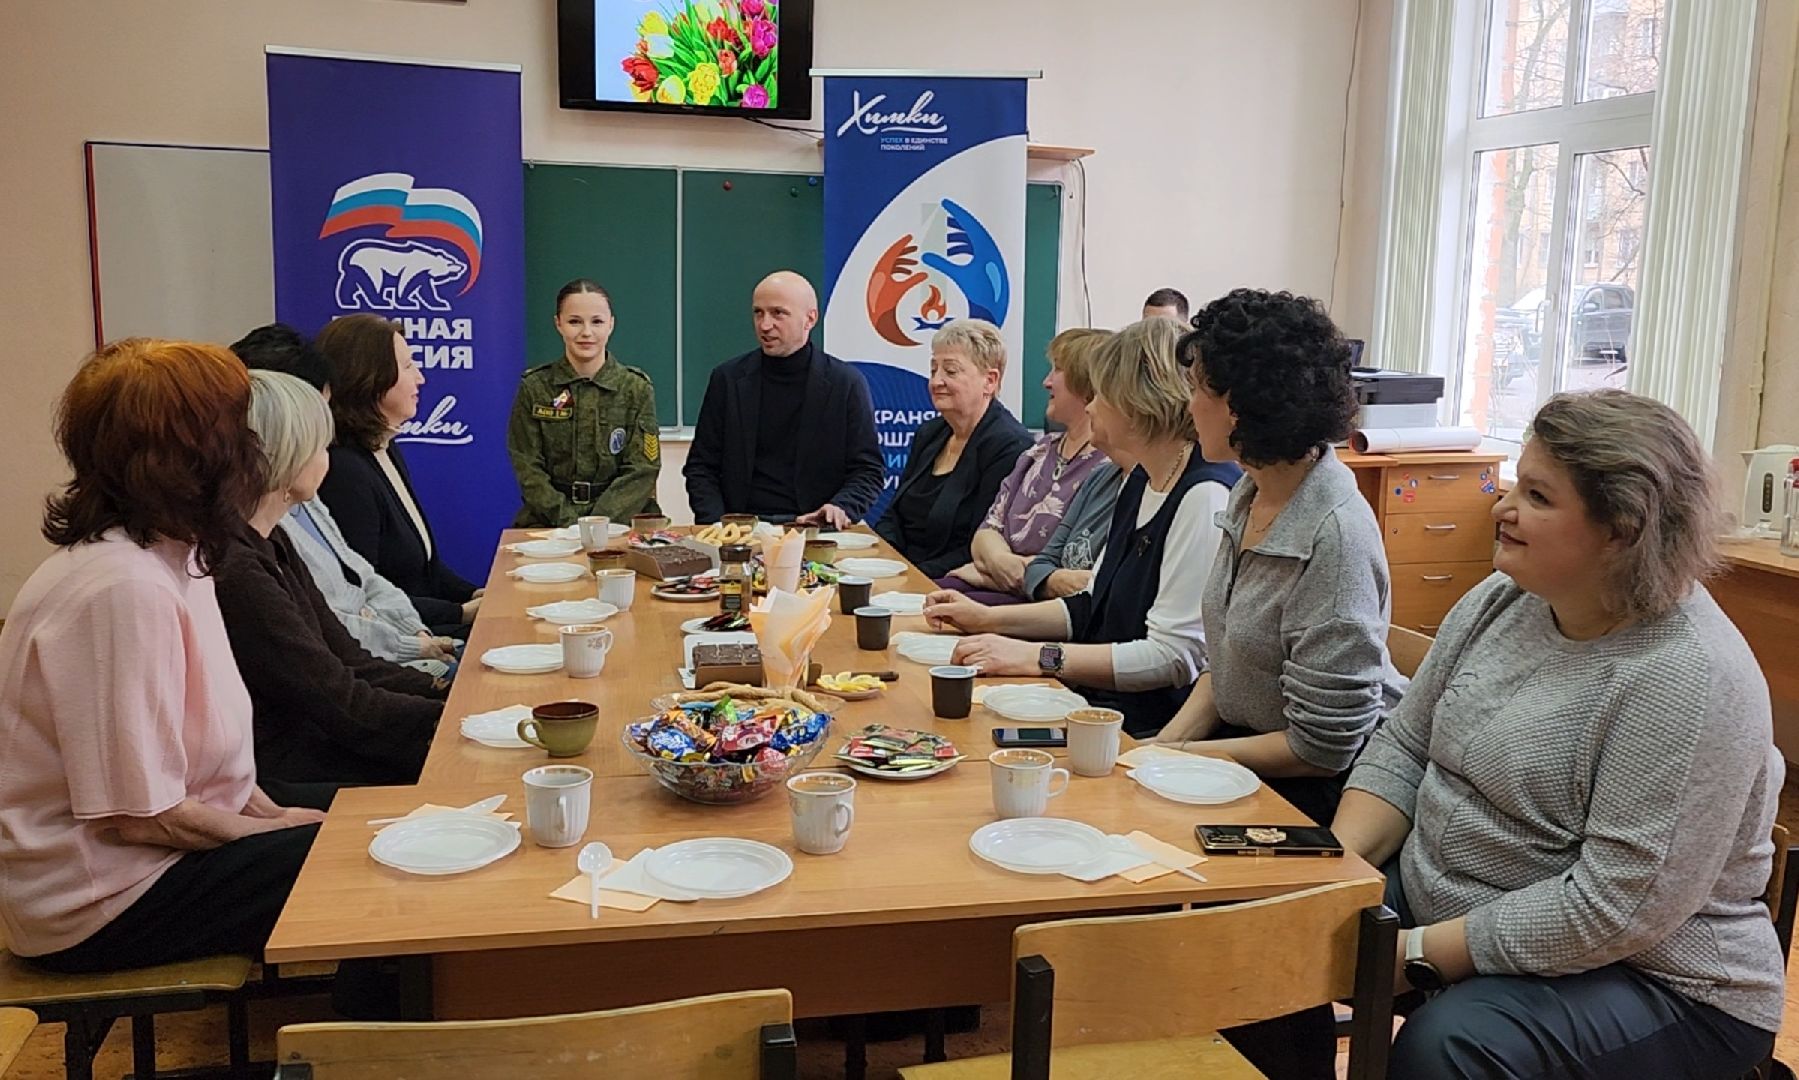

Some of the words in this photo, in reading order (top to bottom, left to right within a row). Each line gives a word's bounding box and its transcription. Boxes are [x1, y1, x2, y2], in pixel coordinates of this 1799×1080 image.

[837, 90, 945, 138] Химки
[409, 345, 473, 369] СИЯ
[400, 395, 469, 436] мки
